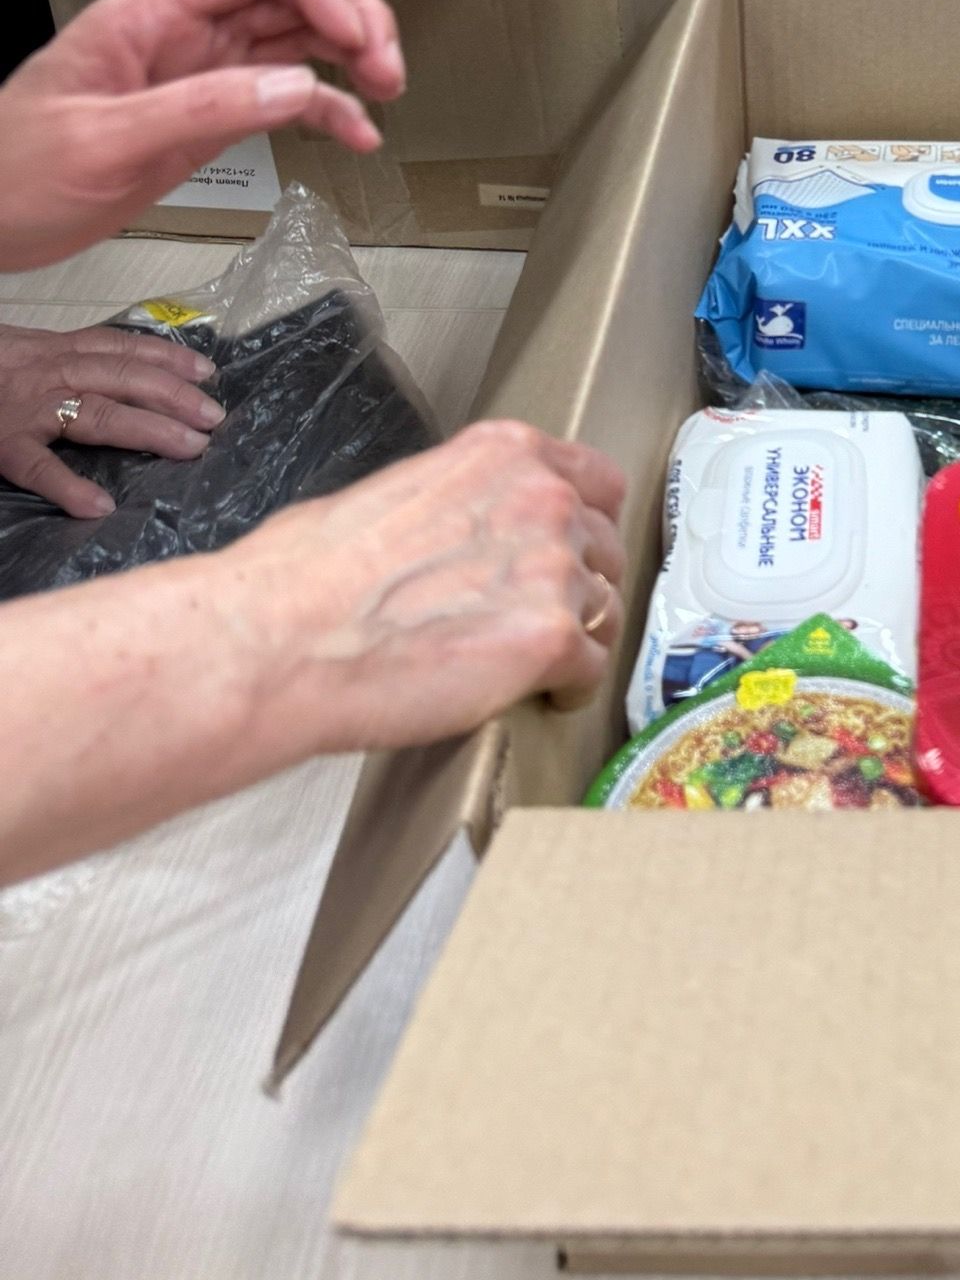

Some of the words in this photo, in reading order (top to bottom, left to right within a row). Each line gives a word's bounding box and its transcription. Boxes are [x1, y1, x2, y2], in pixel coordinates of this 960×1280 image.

[774, 149, 817, 165] 80
[757, 218, 836, 241] XXL
[928, 335, 943, 346] ЗА
[758, 447, 782, 568] УНИВЕРСАЛЬНЫЕ
[789, 465, 809, 542] ЭКОНОМ
